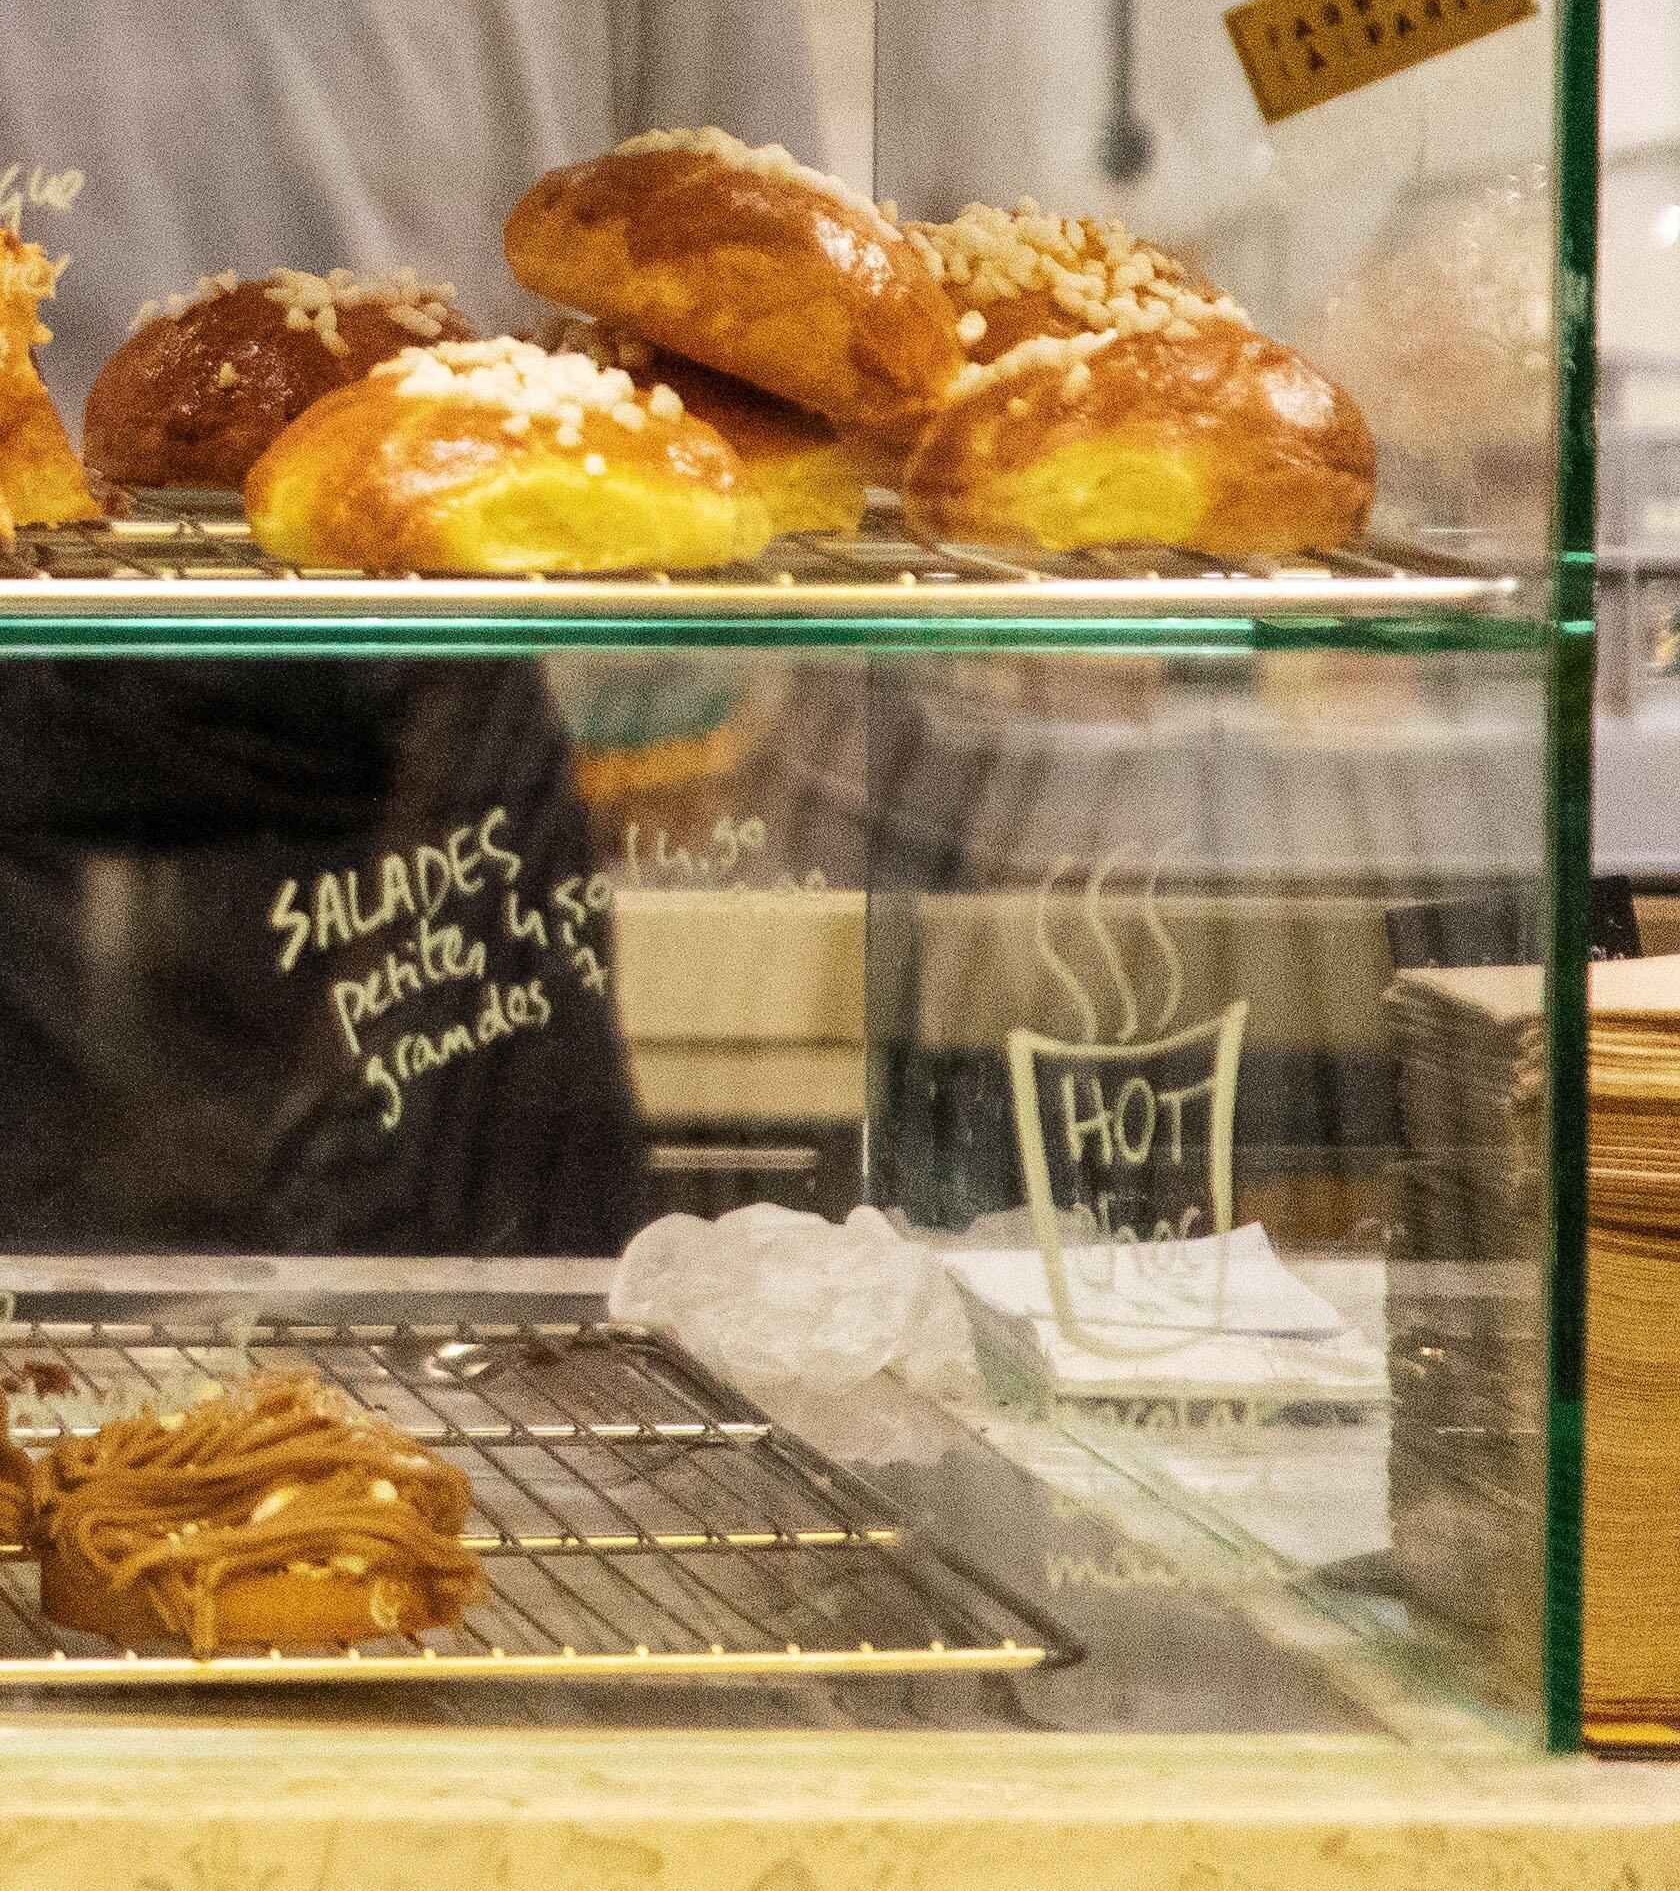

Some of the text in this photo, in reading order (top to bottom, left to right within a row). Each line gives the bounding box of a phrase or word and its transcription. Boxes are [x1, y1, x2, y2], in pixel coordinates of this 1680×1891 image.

[271, 806, 521, 972] SALADES
[365, 979, 550, 1132] grandes
[1063, 1074, 1217, 1167] HOT
